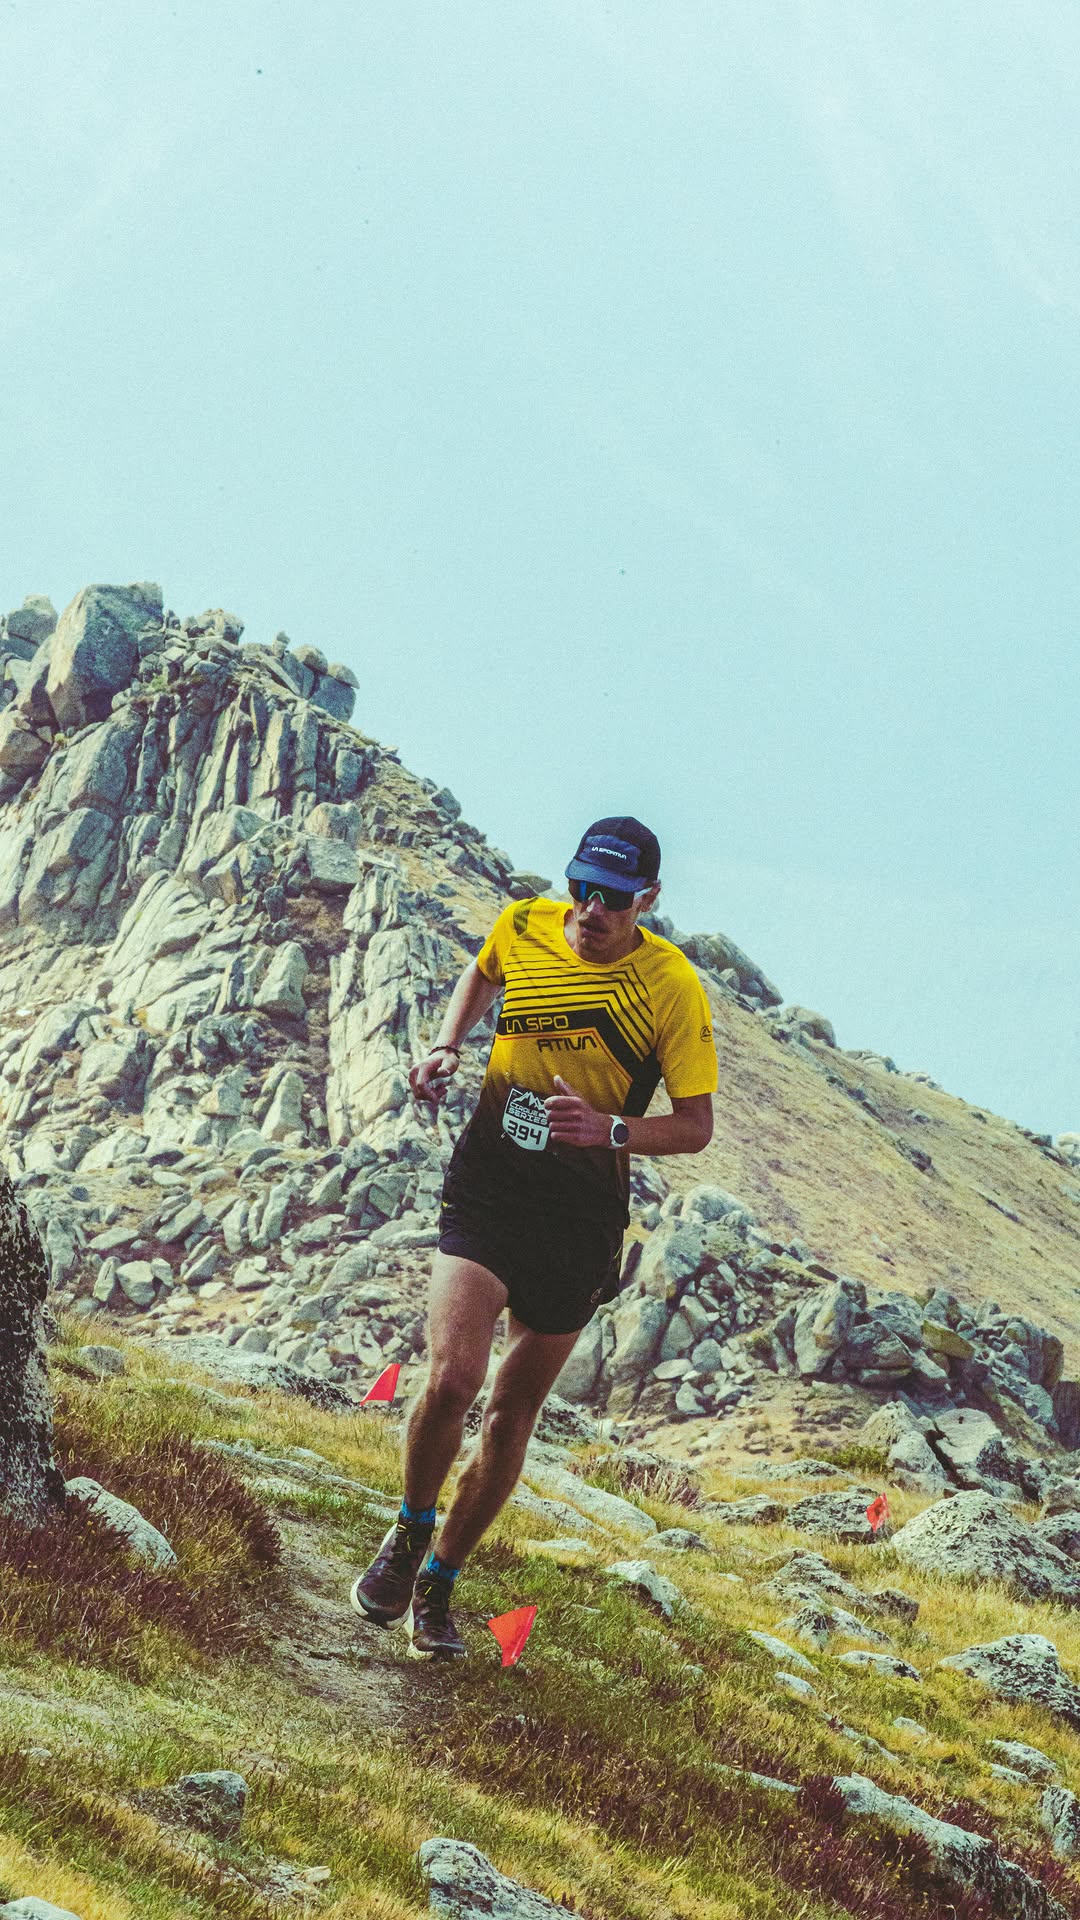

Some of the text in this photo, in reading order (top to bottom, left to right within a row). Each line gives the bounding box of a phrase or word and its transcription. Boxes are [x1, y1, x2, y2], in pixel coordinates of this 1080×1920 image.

[506, 1015, 569, 1033] LA SPO
[508, 1106, 548, 1125] SERIES
[507, 1120, 542, 1145] 394
